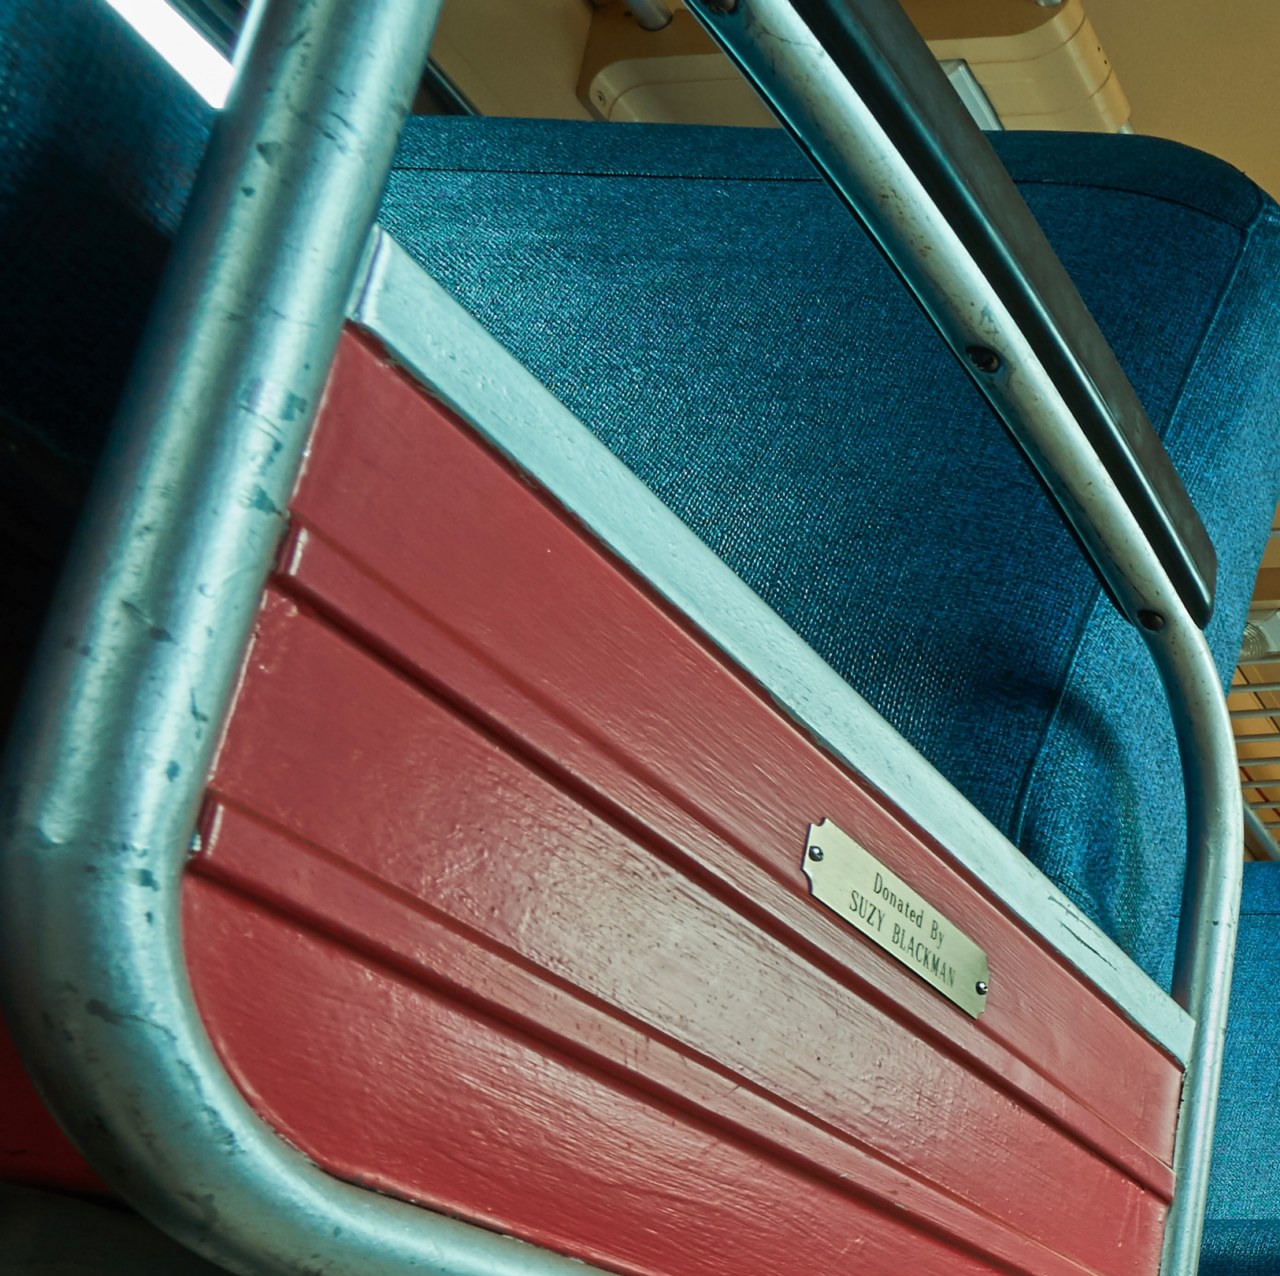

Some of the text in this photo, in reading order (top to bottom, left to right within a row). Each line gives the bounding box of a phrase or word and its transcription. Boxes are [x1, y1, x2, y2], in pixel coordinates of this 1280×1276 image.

[849, 890, 956, 988] SUZY BLACKMAN
[873, 871, 945, 950] Donated By
